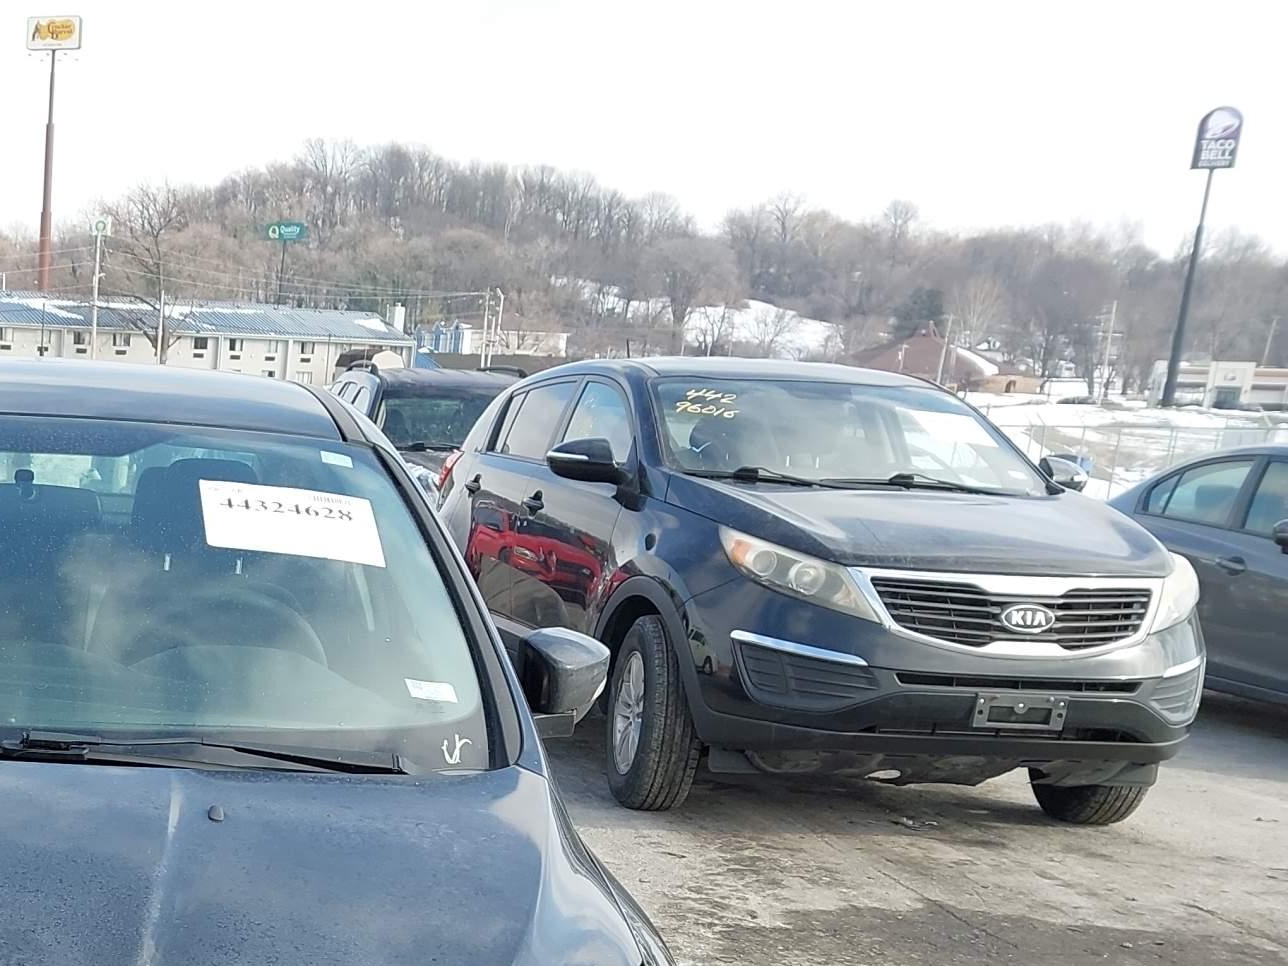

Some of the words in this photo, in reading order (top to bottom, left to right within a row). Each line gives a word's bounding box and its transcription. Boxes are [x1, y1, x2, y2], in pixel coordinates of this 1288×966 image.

[1200, 139, 1236, 150] TACO
[1200, 149, 1233, 160] BELL
[685, 388, 737, 404] 442
[675, 401, 741, 418] 96016
[219, 497, 353, 521] 44324628
[1011, 610, 1046, 626] KIA
